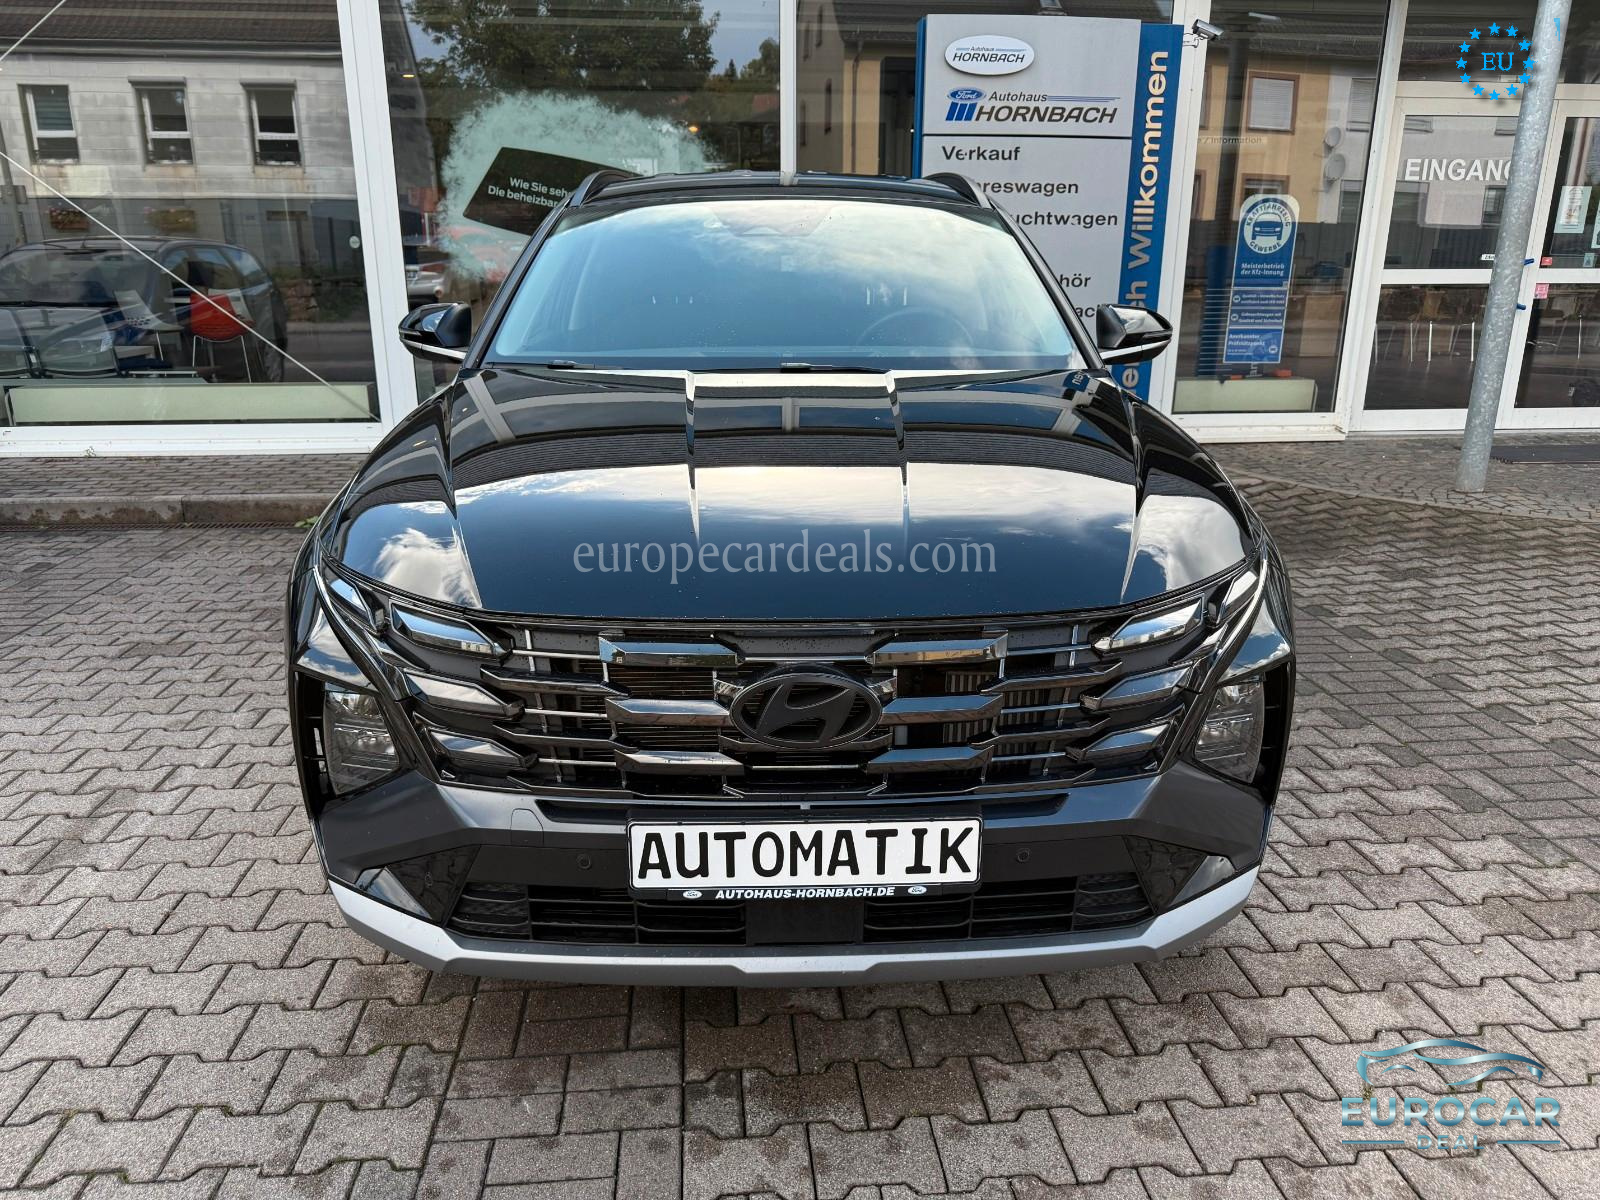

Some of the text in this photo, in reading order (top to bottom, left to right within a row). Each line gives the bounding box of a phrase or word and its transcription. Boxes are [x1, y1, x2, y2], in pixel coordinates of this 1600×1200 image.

[952, 52, 1025, 63] HORNBACH
[988, 91, 1048, 102] Autohaus
[975, 105, 1118, 123] HORNBACH
[942, 146, 1021, 161] Verkauf
[1128, 52, 1169, 269] Willkommen
[510, 177, 529, 190] Wie
[531, 182, 547, 193] Sie
[488, 185, 560, 207] Die beheizbar
[1249, 241, 1281, 252] GEWERBE
[637, 827, 974, 879] AUTOMATIK
[715, 886, 896, 900] AUTOHAUS-HORNBACH.DE
